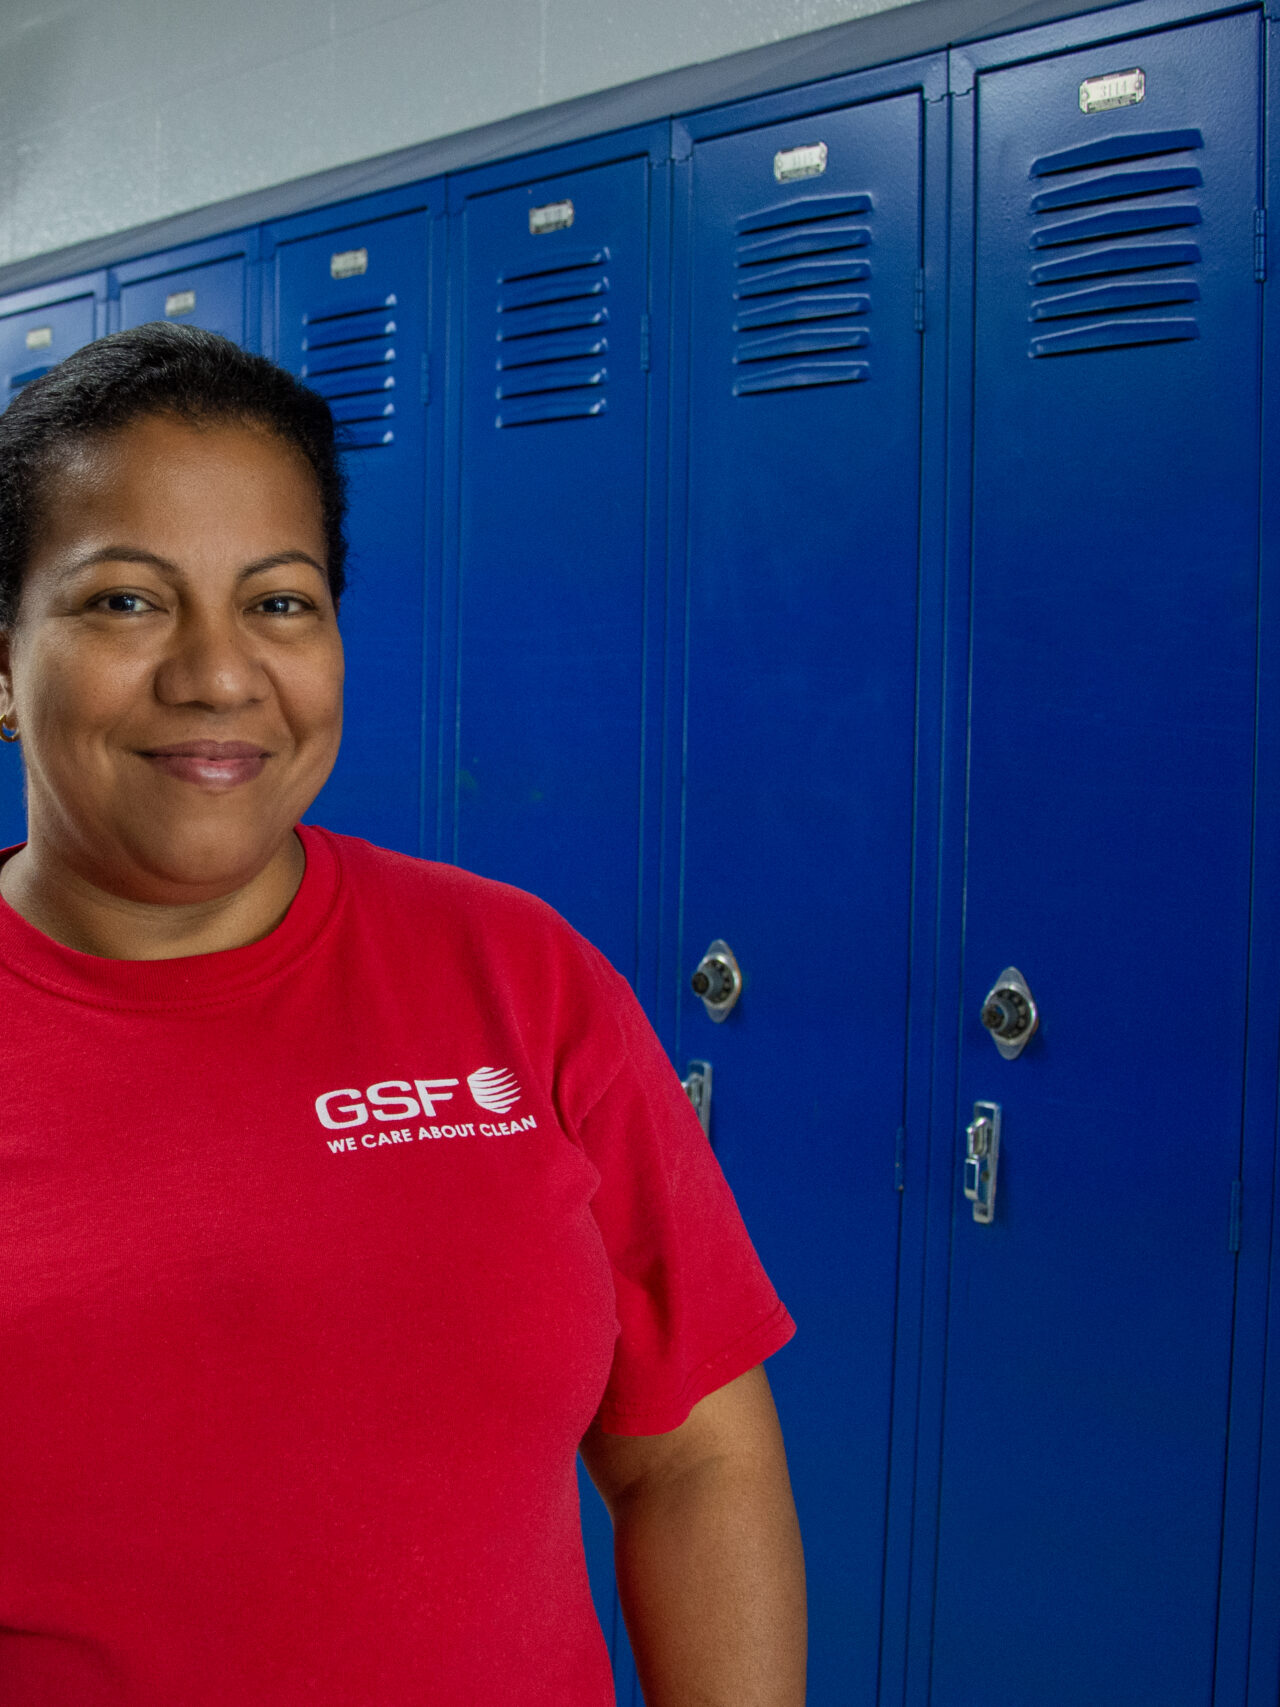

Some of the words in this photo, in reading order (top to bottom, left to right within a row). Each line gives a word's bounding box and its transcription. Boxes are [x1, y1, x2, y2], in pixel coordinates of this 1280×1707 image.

[315, 1078, 459, 1129] GSF
[326, 1136, 358, 1153] WE
[361, 1128, 413, 1148] CARE
[418, 1122, 475, 1140] ABOUT
[479, 1114, 537, 1137] CLEAN
